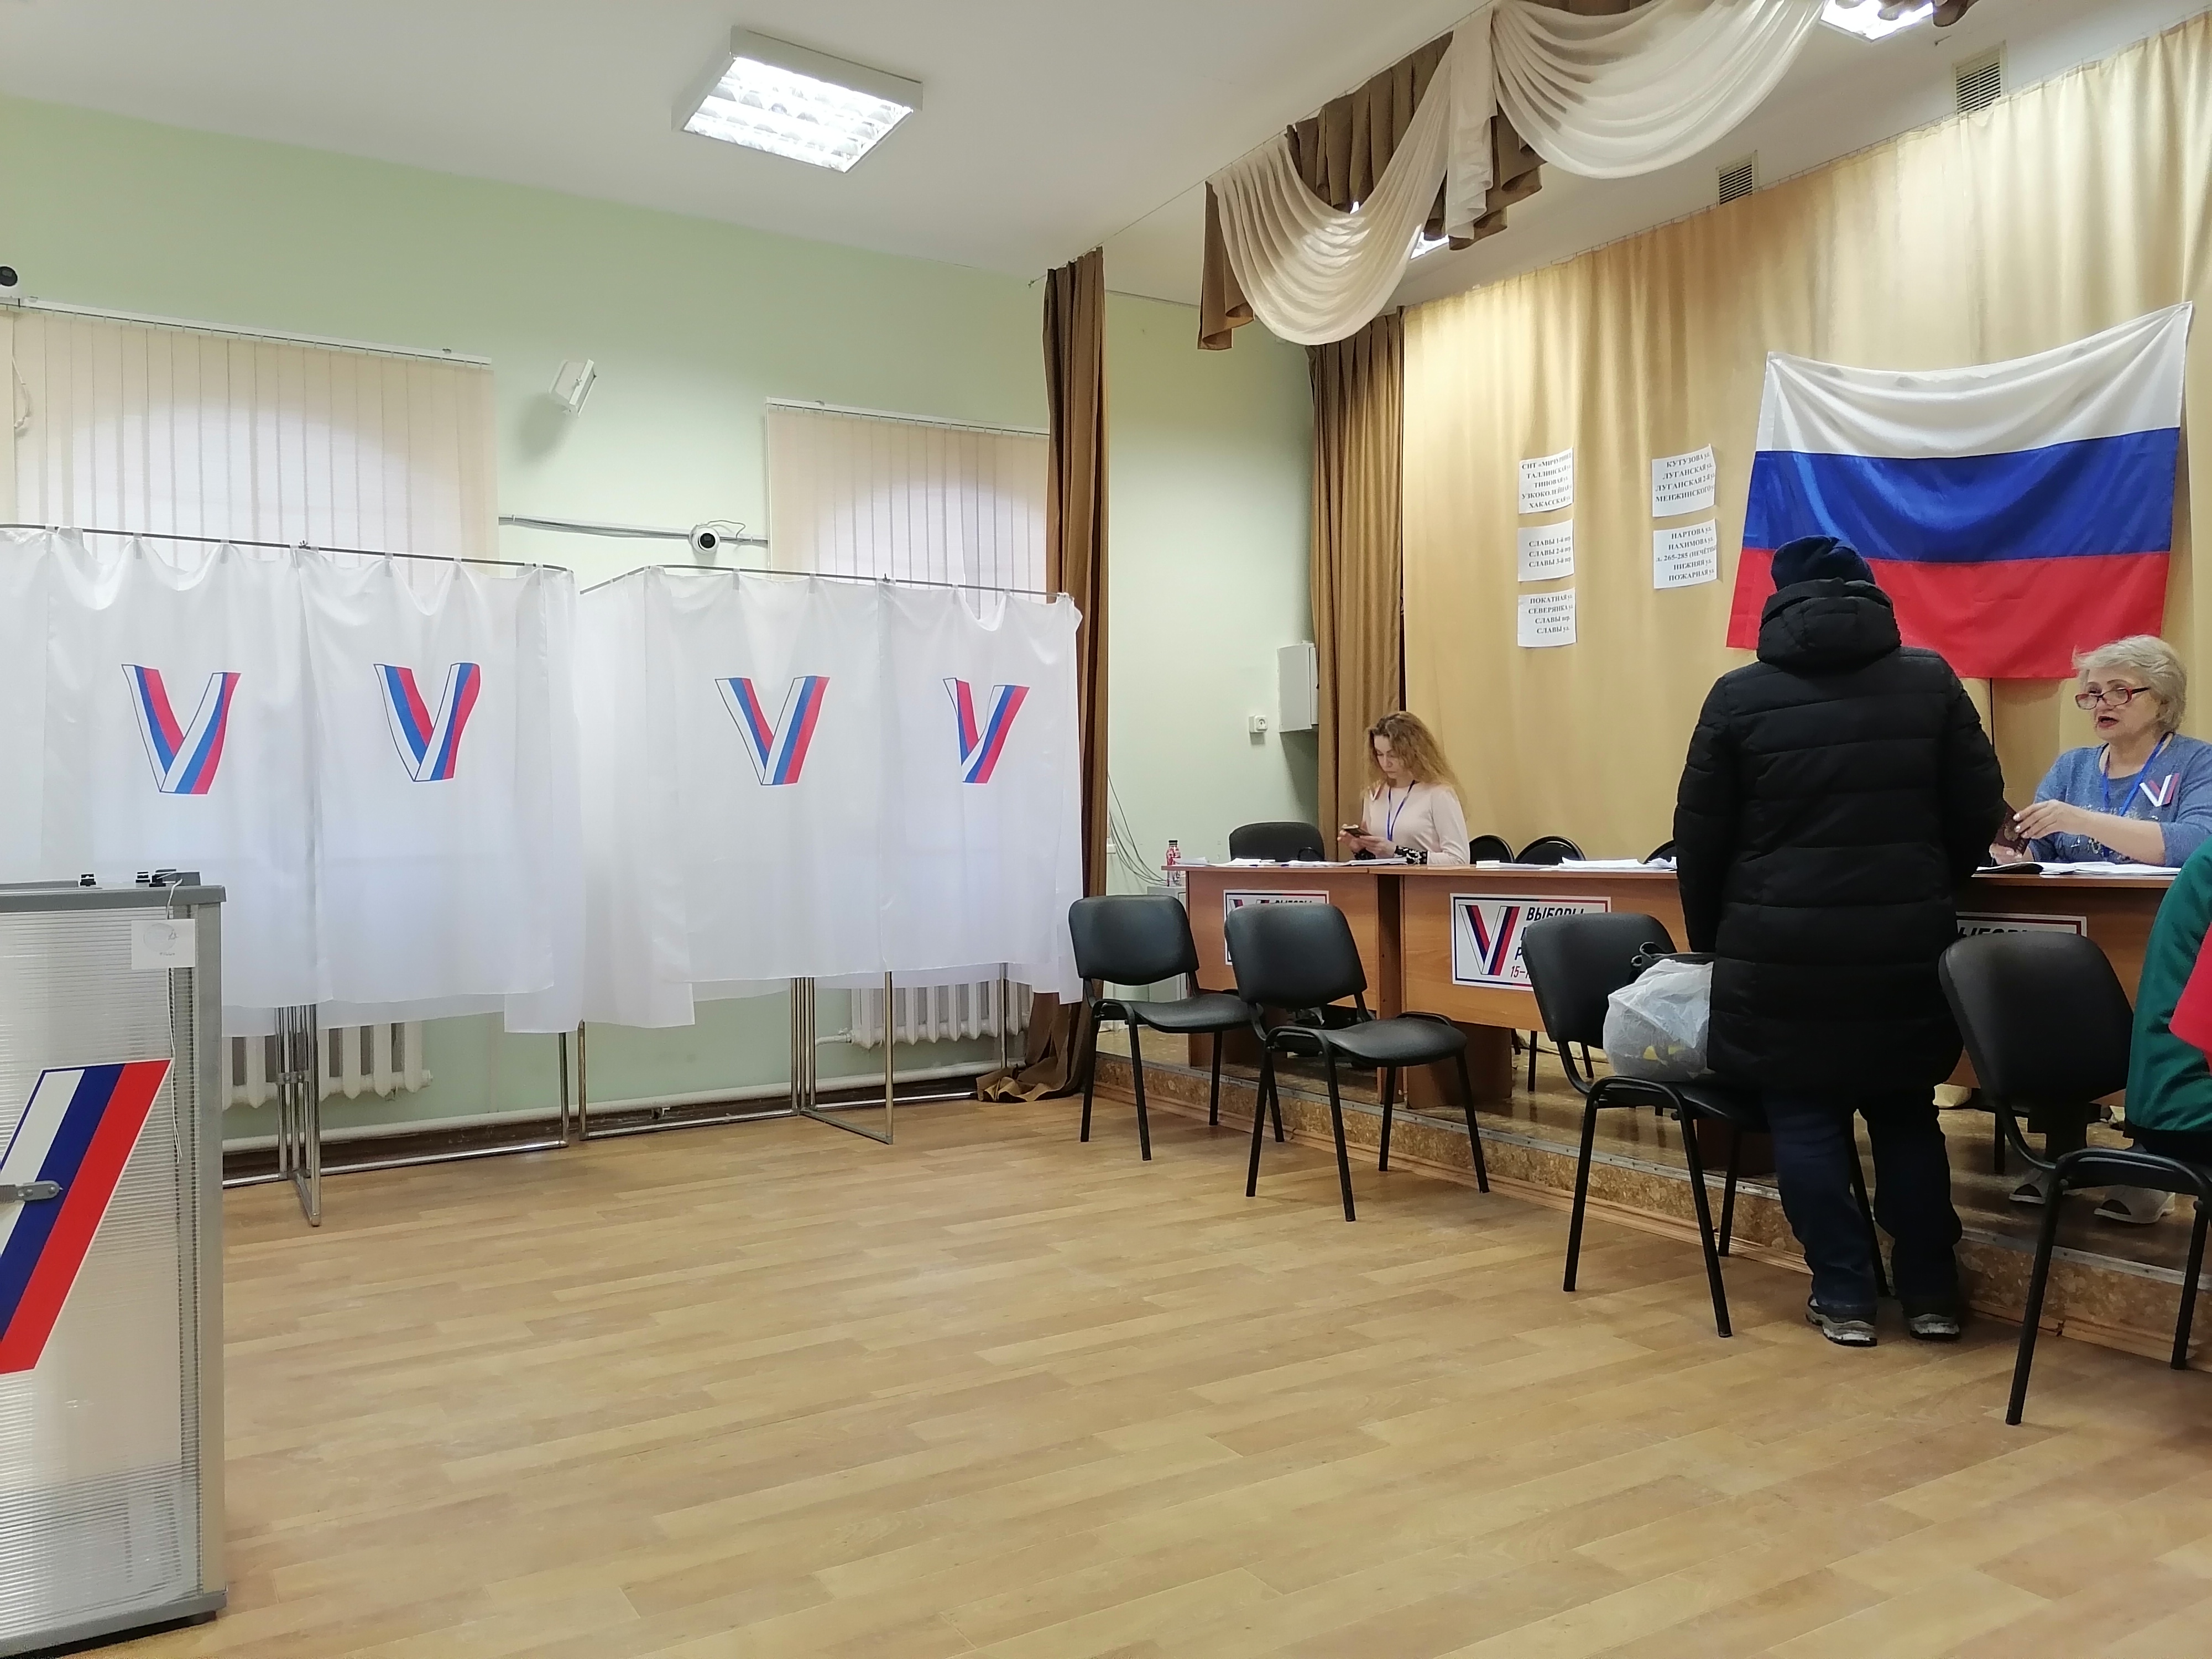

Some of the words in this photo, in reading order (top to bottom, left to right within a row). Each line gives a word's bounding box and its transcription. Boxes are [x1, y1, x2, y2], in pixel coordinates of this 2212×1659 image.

[1667, 453, 1703, 468] КУТУЗОВА
[1526, 465, 1567, 479] ТАЛЛИНСКАЯ
[1662, 463, 1706, 479] ЛУГАНСКАЯ
[1534, 477, 1563, 488] ТИПОВАЯ
[1655, 477, 1702, 492] ЛУГАНСКАЯ
[1655, 485, 1711, 502] МЕНЖИНСКОГО
[1529, 496, 1566, 508] ХАКАССКАЯ
[1671, 528, 1704, 539] НАРТОВА
[1529, 539, 1554, 547] СЛАВЫ
[1668, 538, 1707, 550] НАХИМОВА
[1529, 549, 1554, 557] СЛАВЫ
[1664, 552, 1688, 561] 265-285
[1529, 559, 1554, 567] СЛАВЫ
[1673, 559, 1704, 570] НИЖНЯЯ
[1668, 569, 1708, 581] ПОЖАРНАЯ
[1530, 594, 1567, 604] ПОКАТНАЯ
[1528, 605, 1567, 614] СЕВЕРЯНКА
[1459, 904, 1520, 975] V
